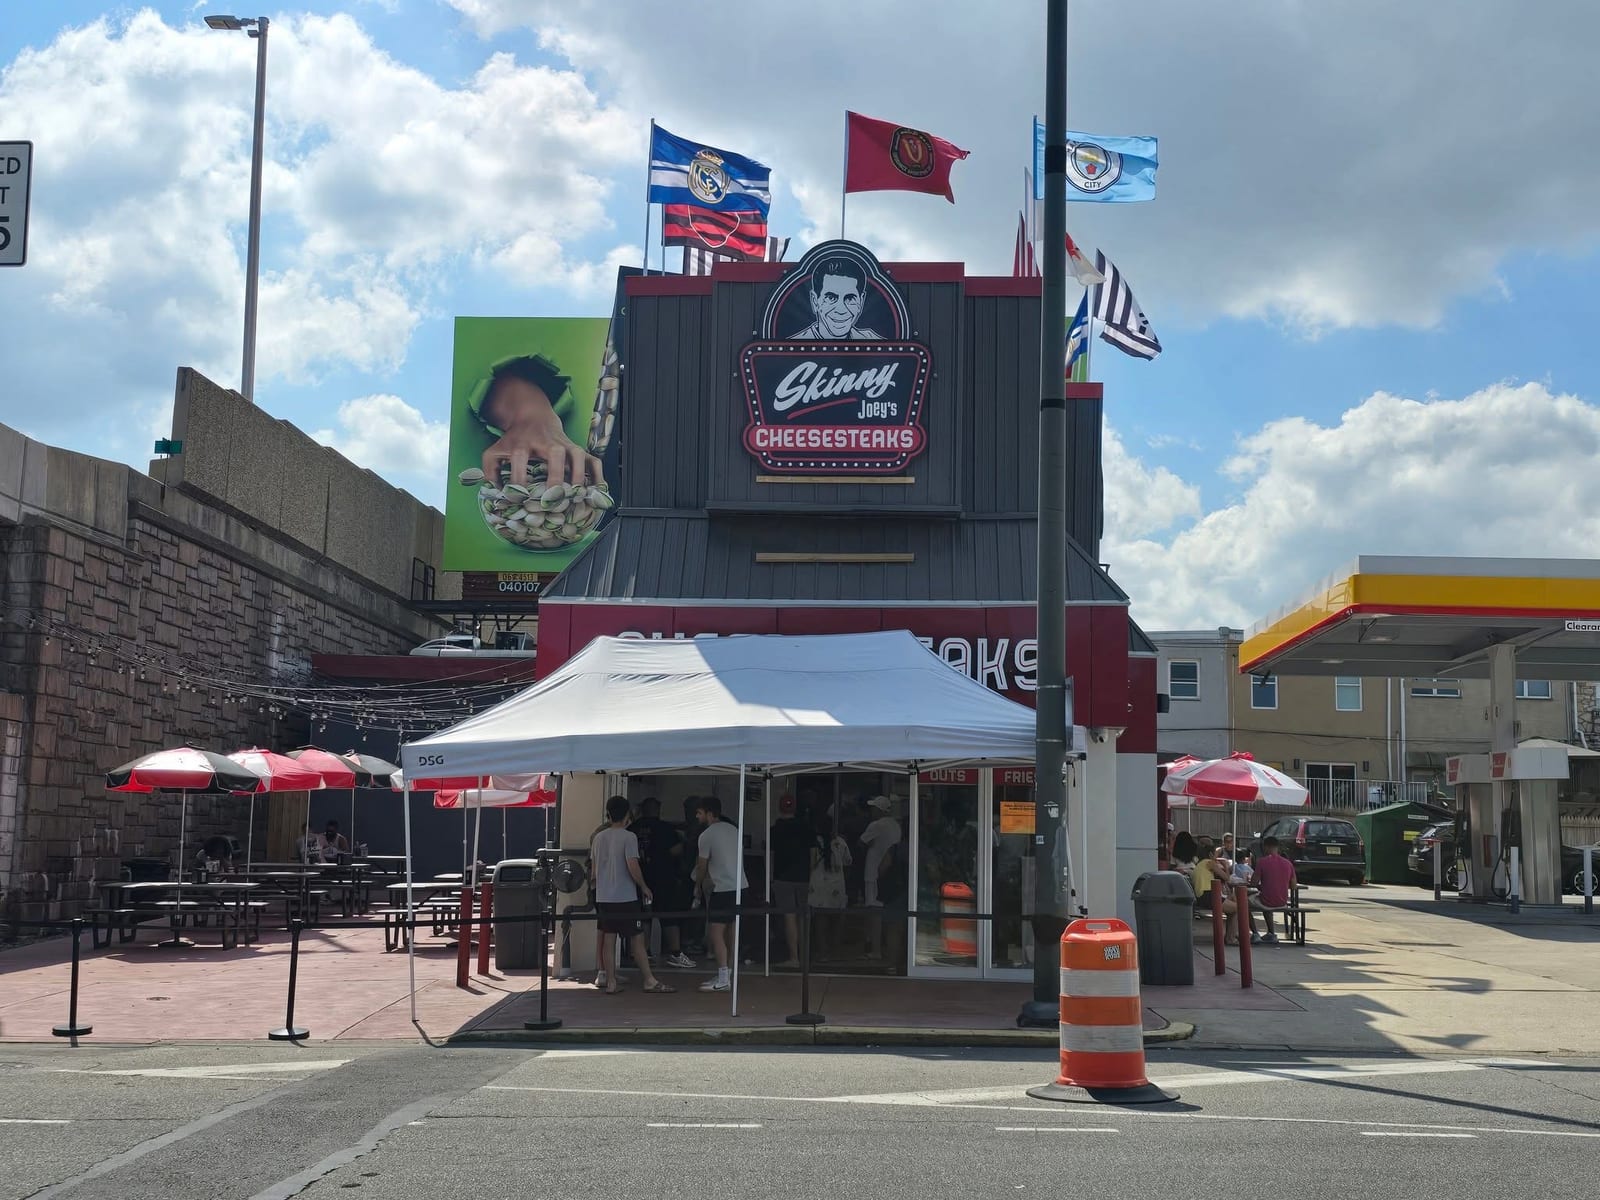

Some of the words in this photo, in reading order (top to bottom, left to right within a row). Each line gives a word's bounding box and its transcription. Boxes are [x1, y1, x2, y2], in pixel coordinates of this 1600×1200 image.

[773, 361, 899, 411] Skinny
[857, 399, 898, 419] Joey's
[756, 429, 913, 448] CHEESESTEAKS
[498, 581, 541, 592] 040107
[418, 754, 444, 766] DSG
[1004, 770, 1037, 784] FRIE
